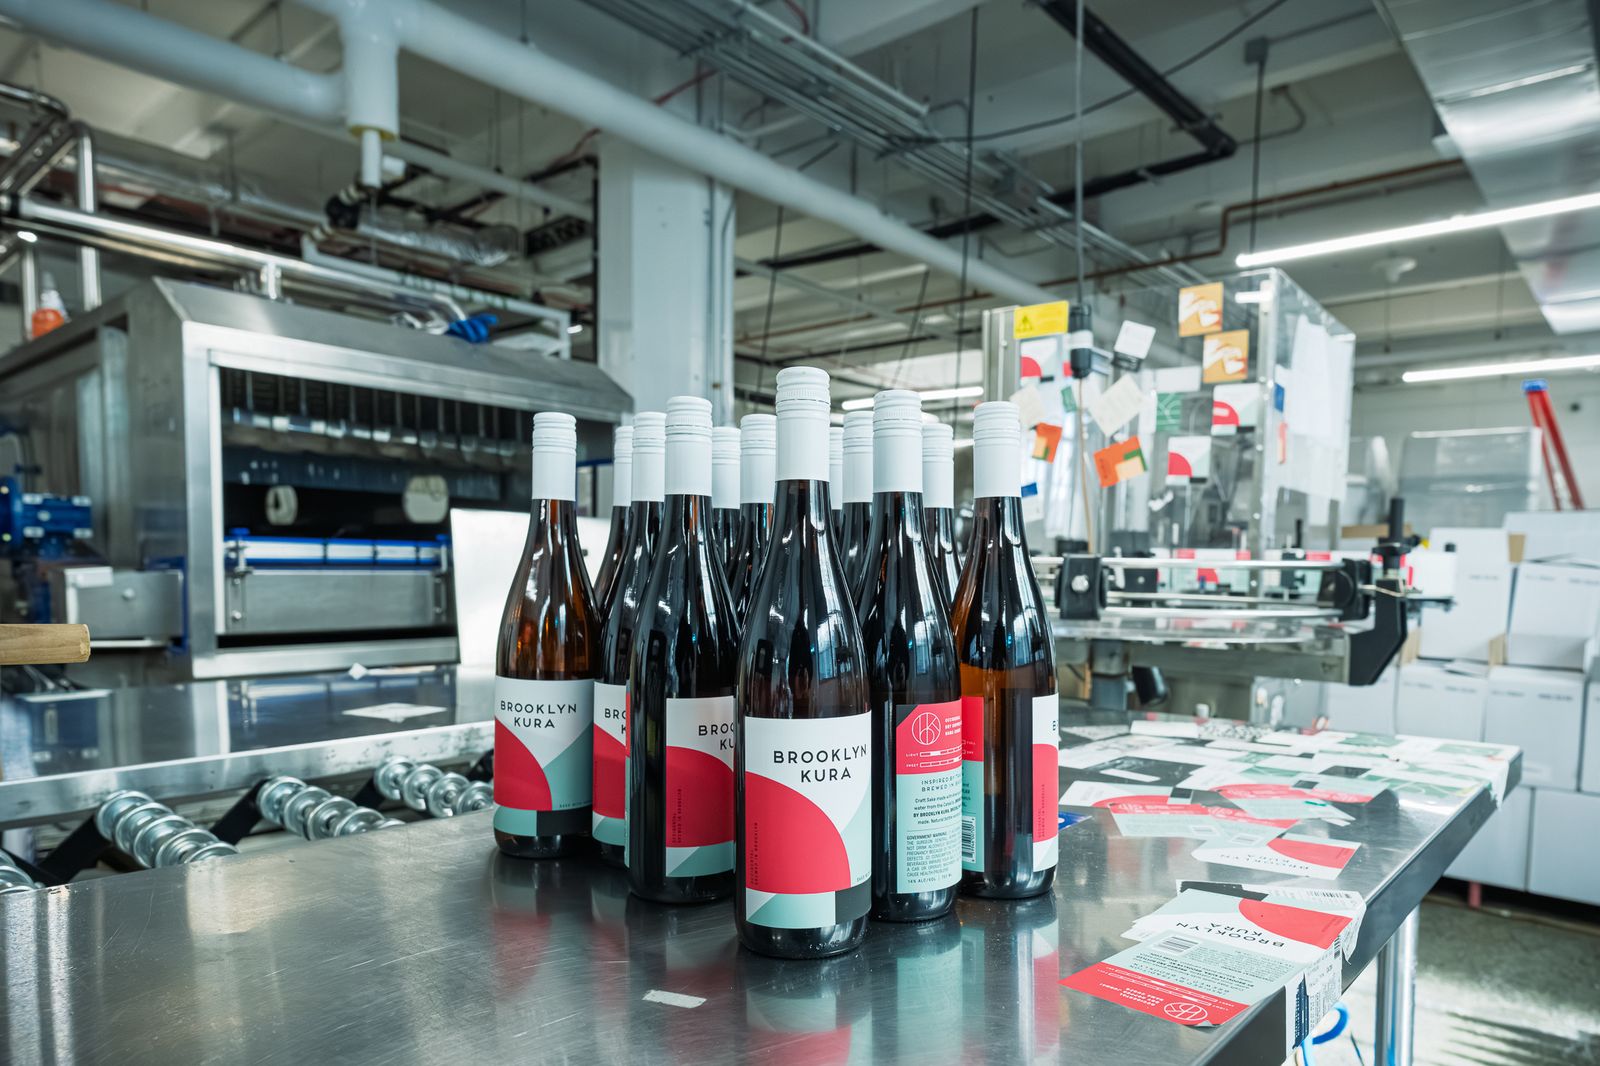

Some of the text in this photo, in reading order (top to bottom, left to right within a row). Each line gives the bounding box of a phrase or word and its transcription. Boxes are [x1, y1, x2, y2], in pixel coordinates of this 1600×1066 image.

[500, 700, 577, 714] BROOKLYN
[514, 718, 555, 729] KURA
[773, 743, 867, 764] BROOKLYN
[800, 768, 852, 783] KURA
[1176, 922, 1285, 948] BROOKLYN
[1210, 923, 1262, 937] KURA
